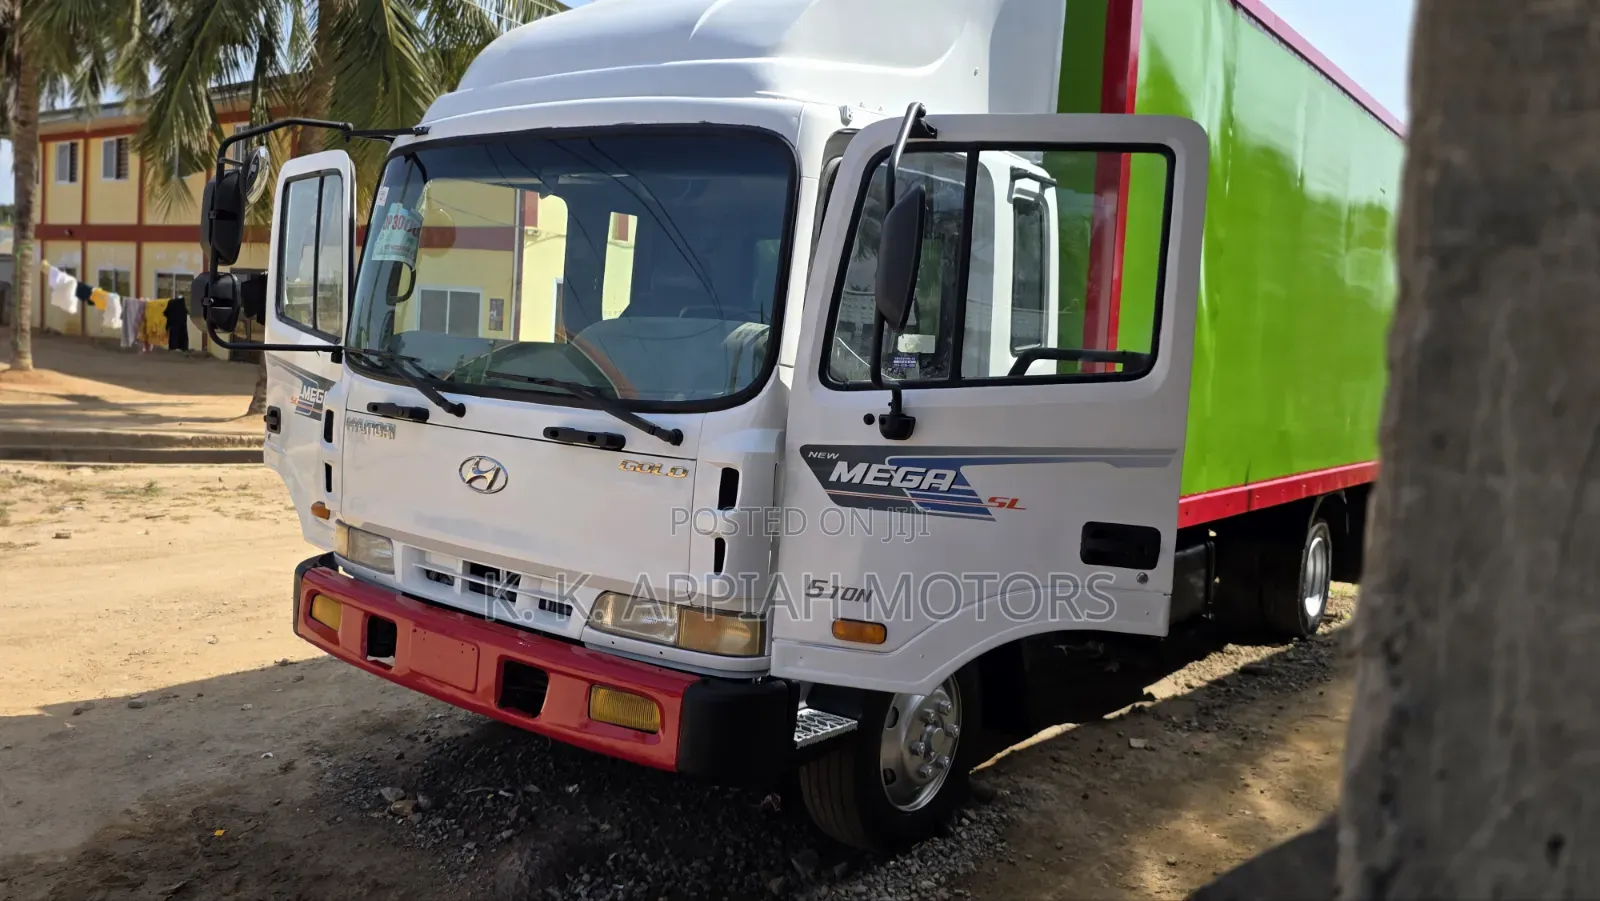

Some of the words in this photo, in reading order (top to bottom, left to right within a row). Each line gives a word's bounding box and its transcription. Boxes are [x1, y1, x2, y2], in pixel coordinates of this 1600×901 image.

[808, 451, 839, 460] NEW
[829, 461, 957, 492] MEGA
[988, 496, 1027, 511] SL
